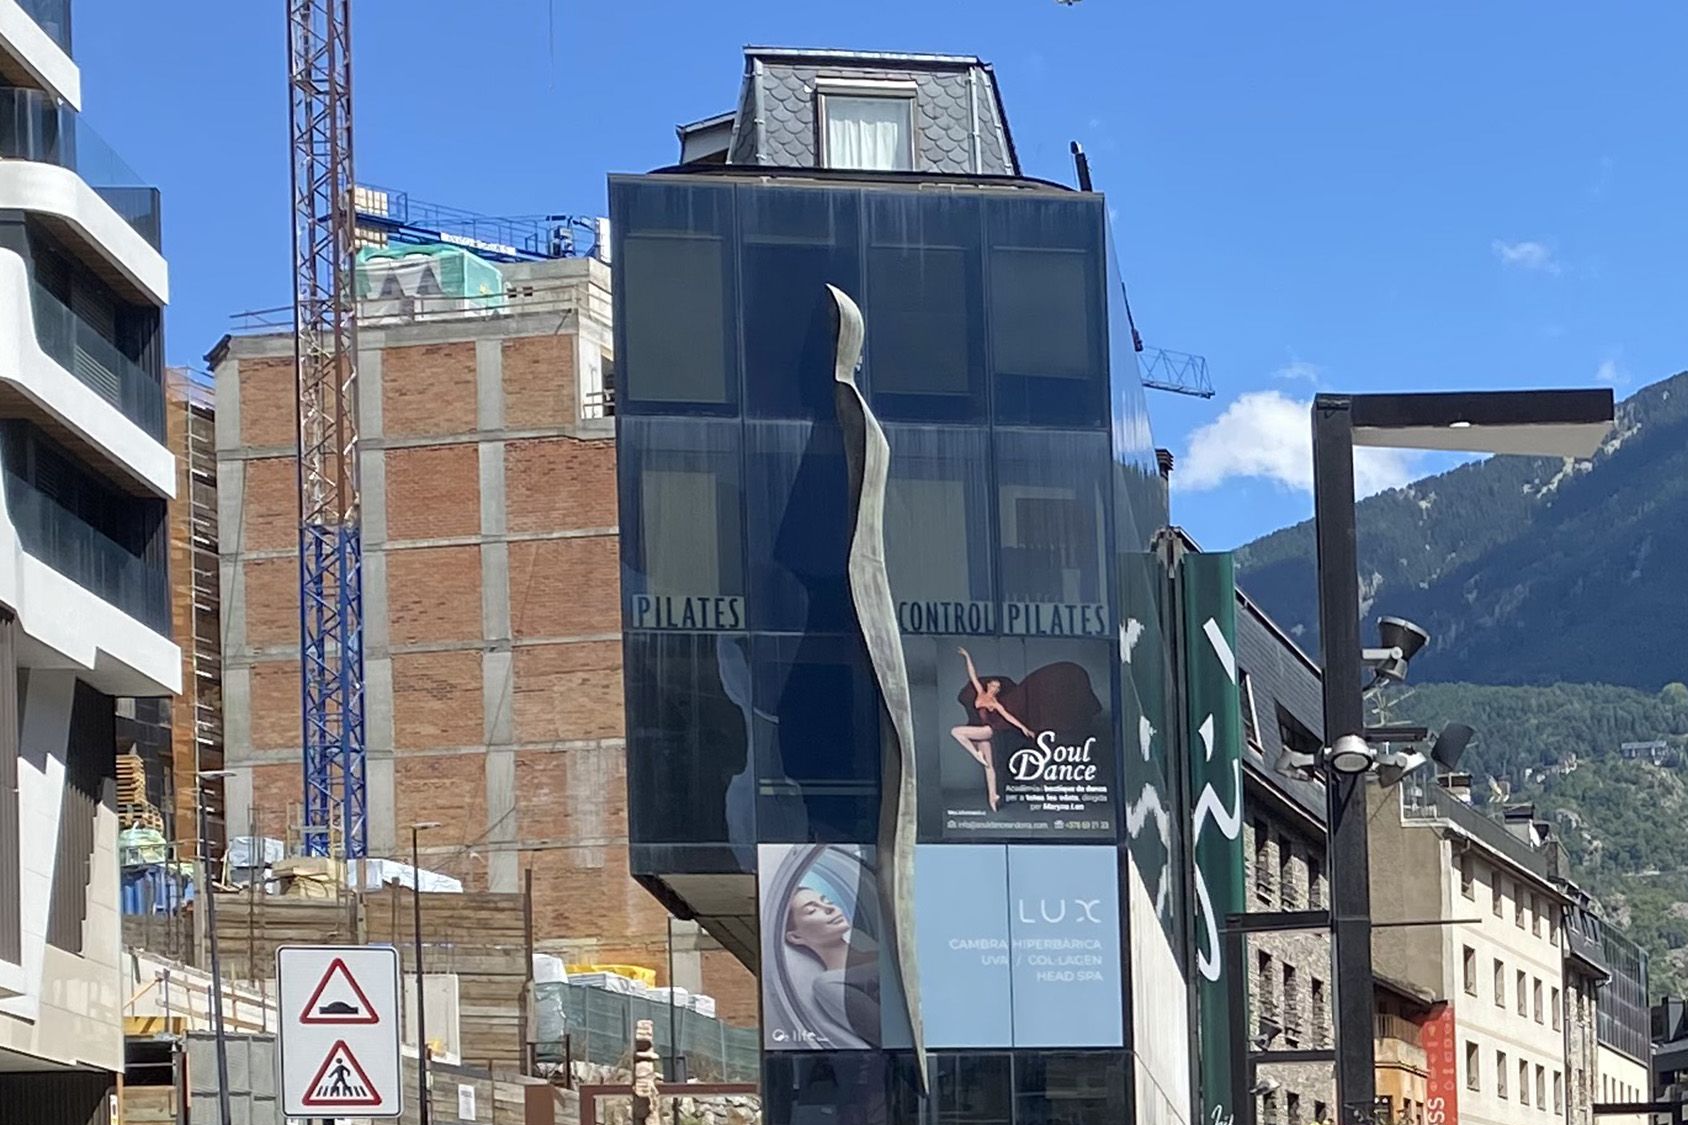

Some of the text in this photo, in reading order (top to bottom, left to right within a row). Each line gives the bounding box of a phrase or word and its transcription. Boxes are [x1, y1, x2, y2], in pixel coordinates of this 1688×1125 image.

[637, 596, 740, 628] PILATES
[900, 601, 1105, 635] CONTROL PILATES
[1036, 731, 1097, 763] Soul
[1009, 749, 1097, 781] Dance
[1019, 899, 1101, 923] LUX
[949, 938, 1008, 949] CAMBRA
[982, 955, 1009, 965] UVA
[1037, 971, 1103, 981] HEAD SPA
